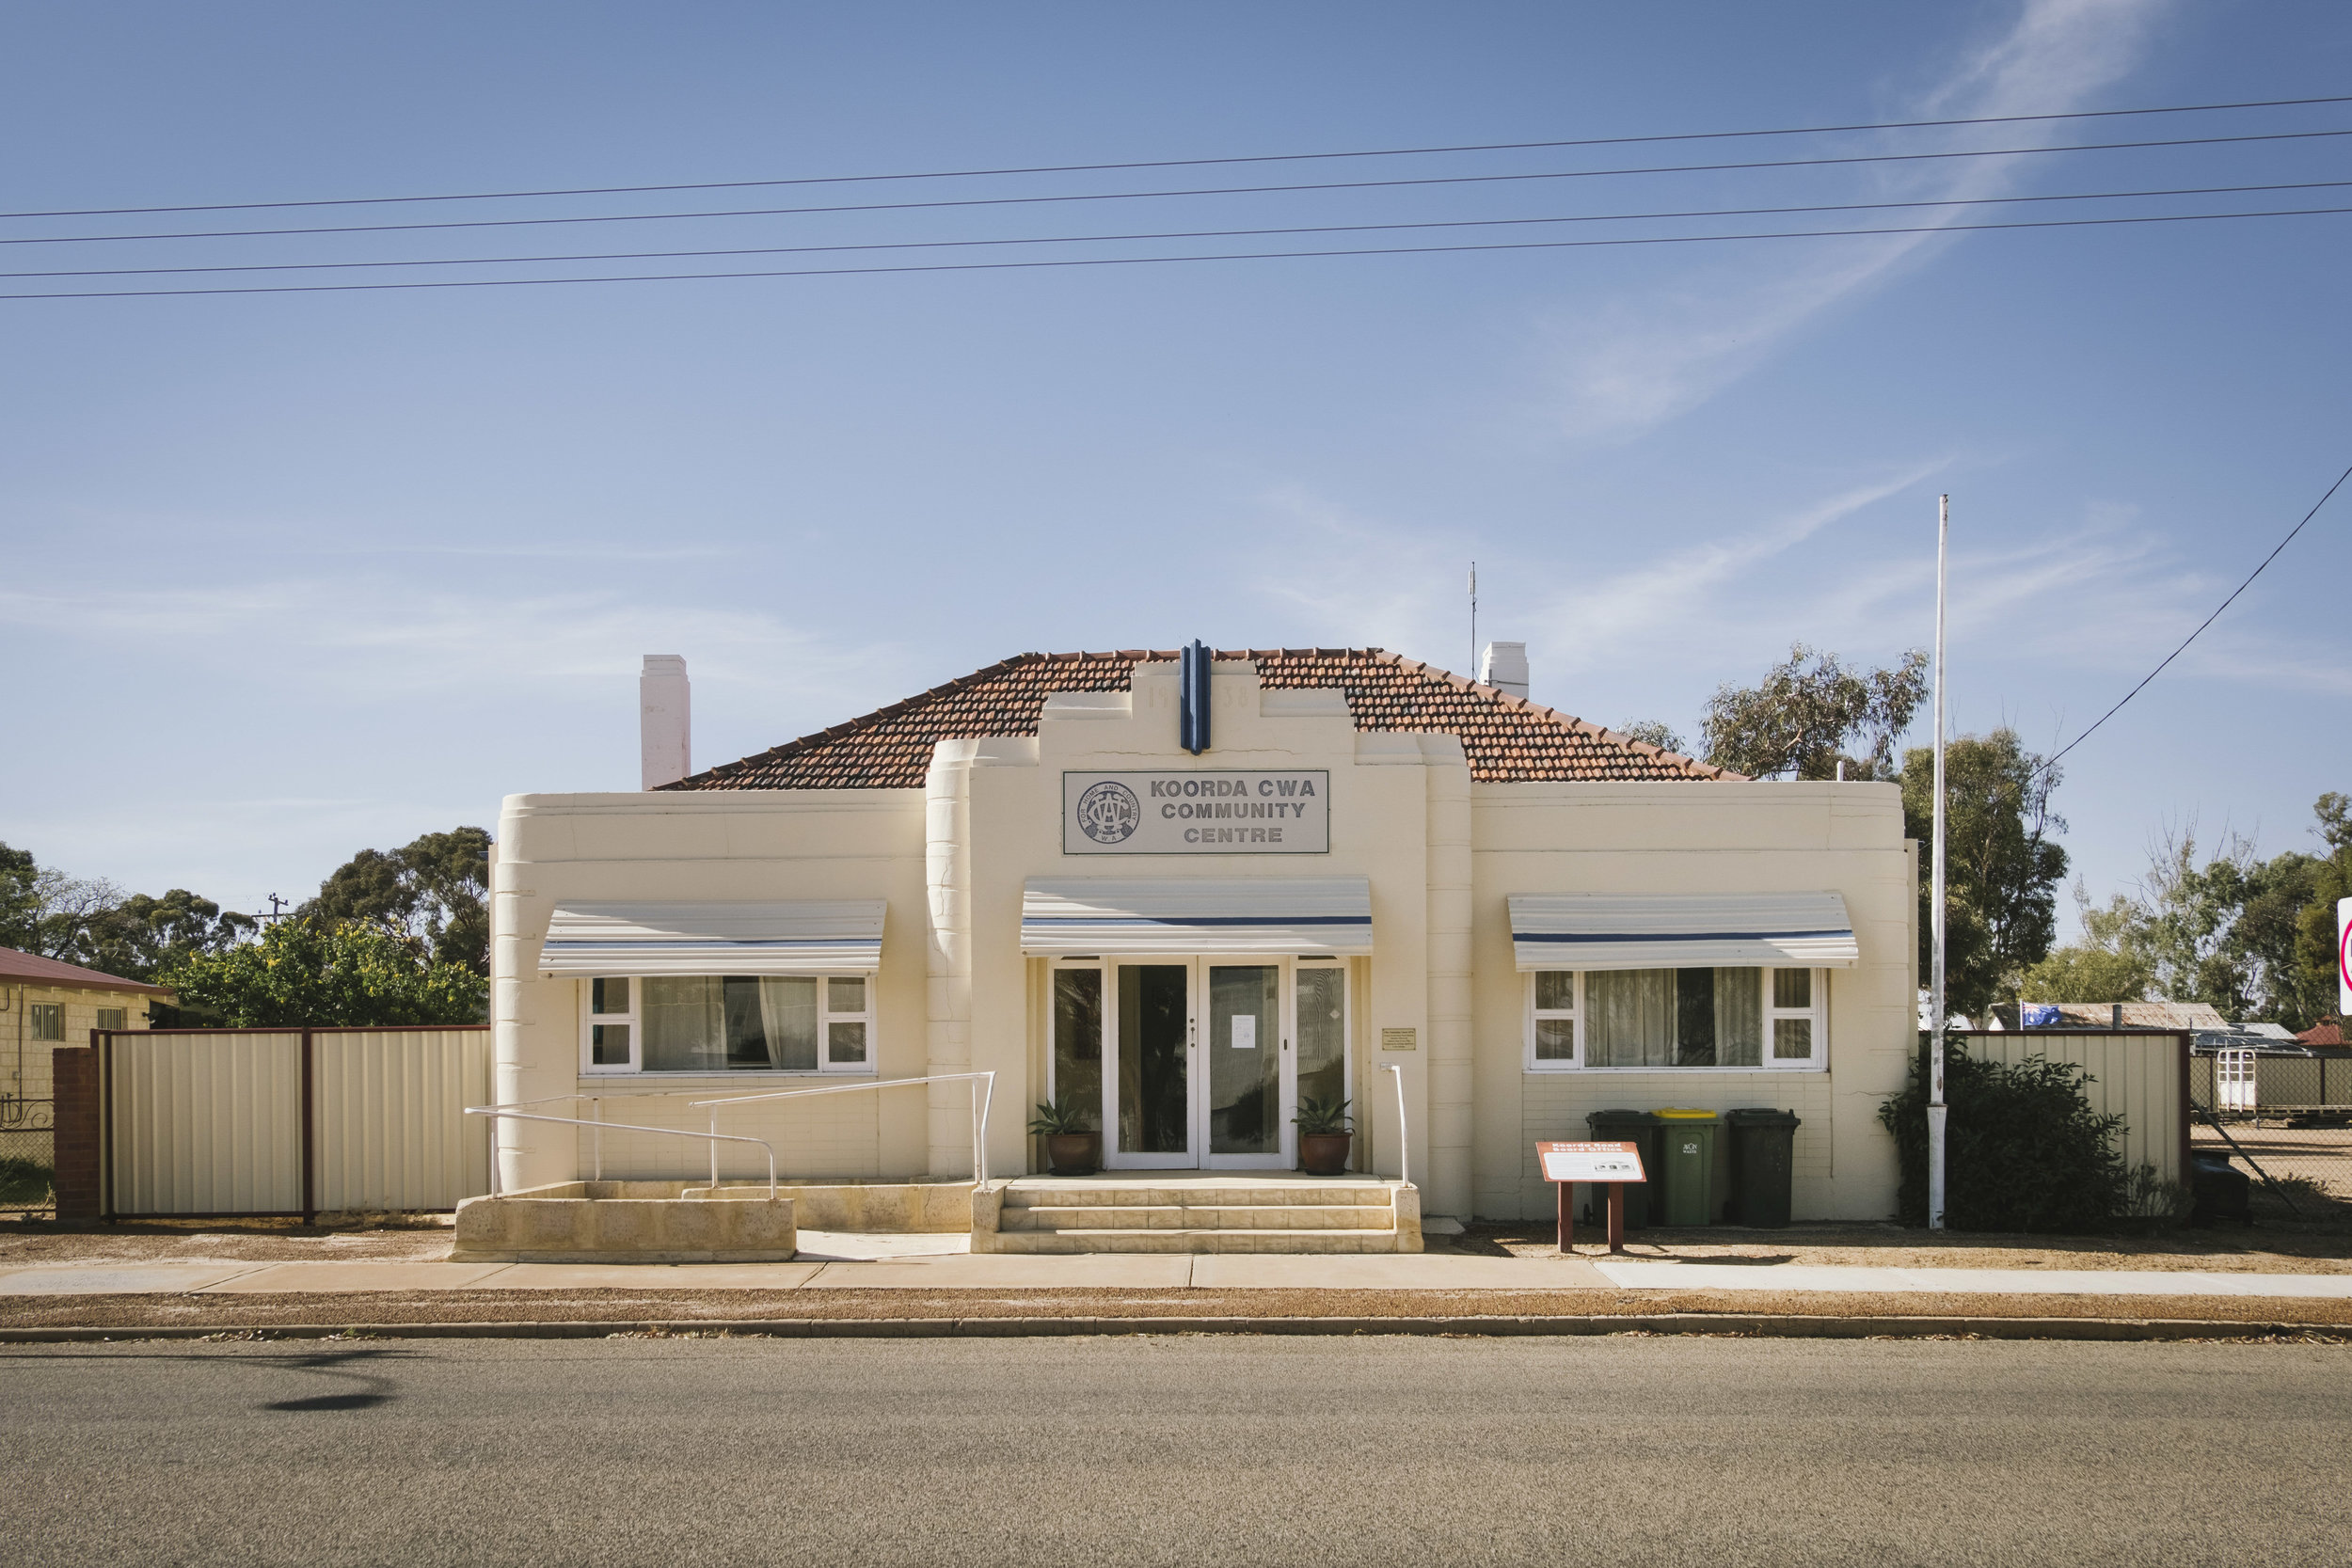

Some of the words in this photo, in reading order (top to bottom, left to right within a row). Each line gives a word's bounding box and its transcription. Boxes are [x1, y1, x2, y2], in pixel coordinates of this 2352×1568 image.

[1151, 780, 1248, 798] KOORDA
[1258, 780, 1316, 797] CWA
[1083, 787, 1099, 804] HOME
[1121, 790, 1137, 821] COUNTRY
[1161, 802, 1306, 819] COMMUNITY
[1184, 828, 1283, 844] CENTRE
